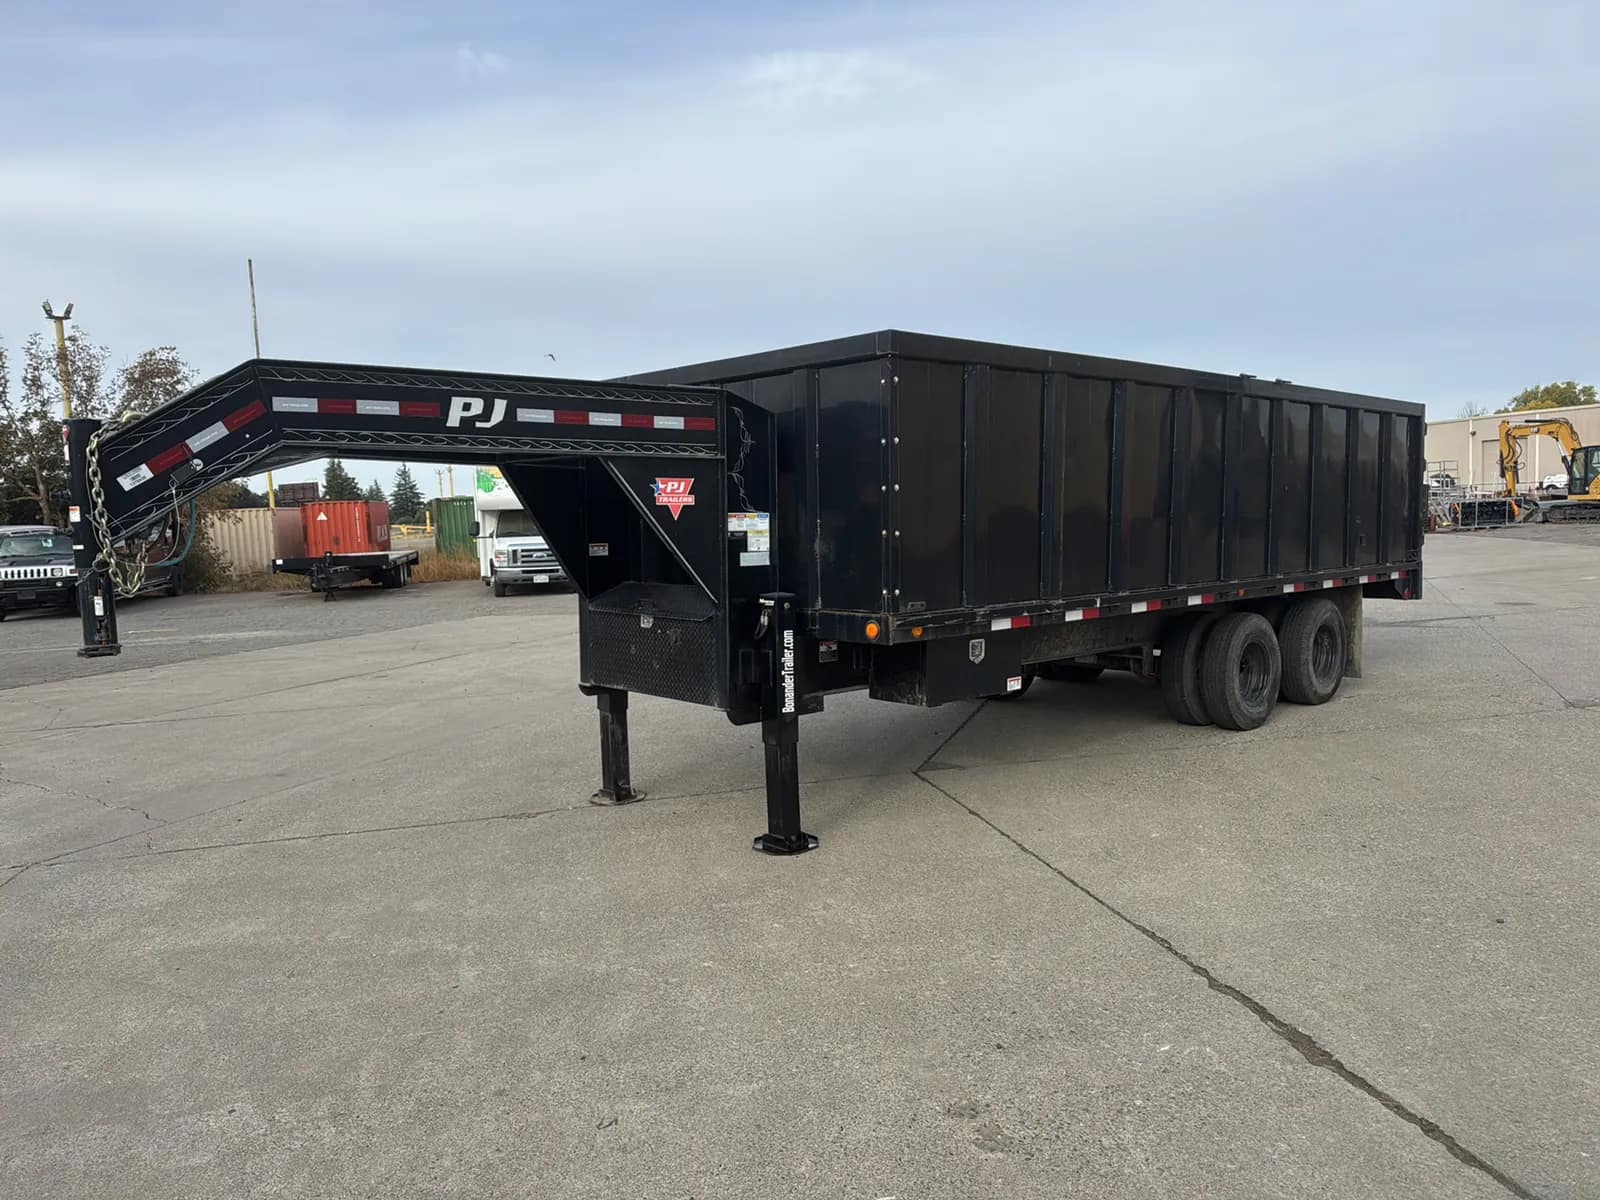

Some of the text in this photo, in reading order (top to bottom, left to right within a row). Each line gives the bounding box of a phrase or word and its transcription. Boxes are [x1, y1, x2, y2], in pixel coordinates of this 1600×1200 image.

[446, 396, 508, 428] PJ
[666, 481, 686, 493] PJ
[781, 629, 795, 713] BonanderTrailer.com
